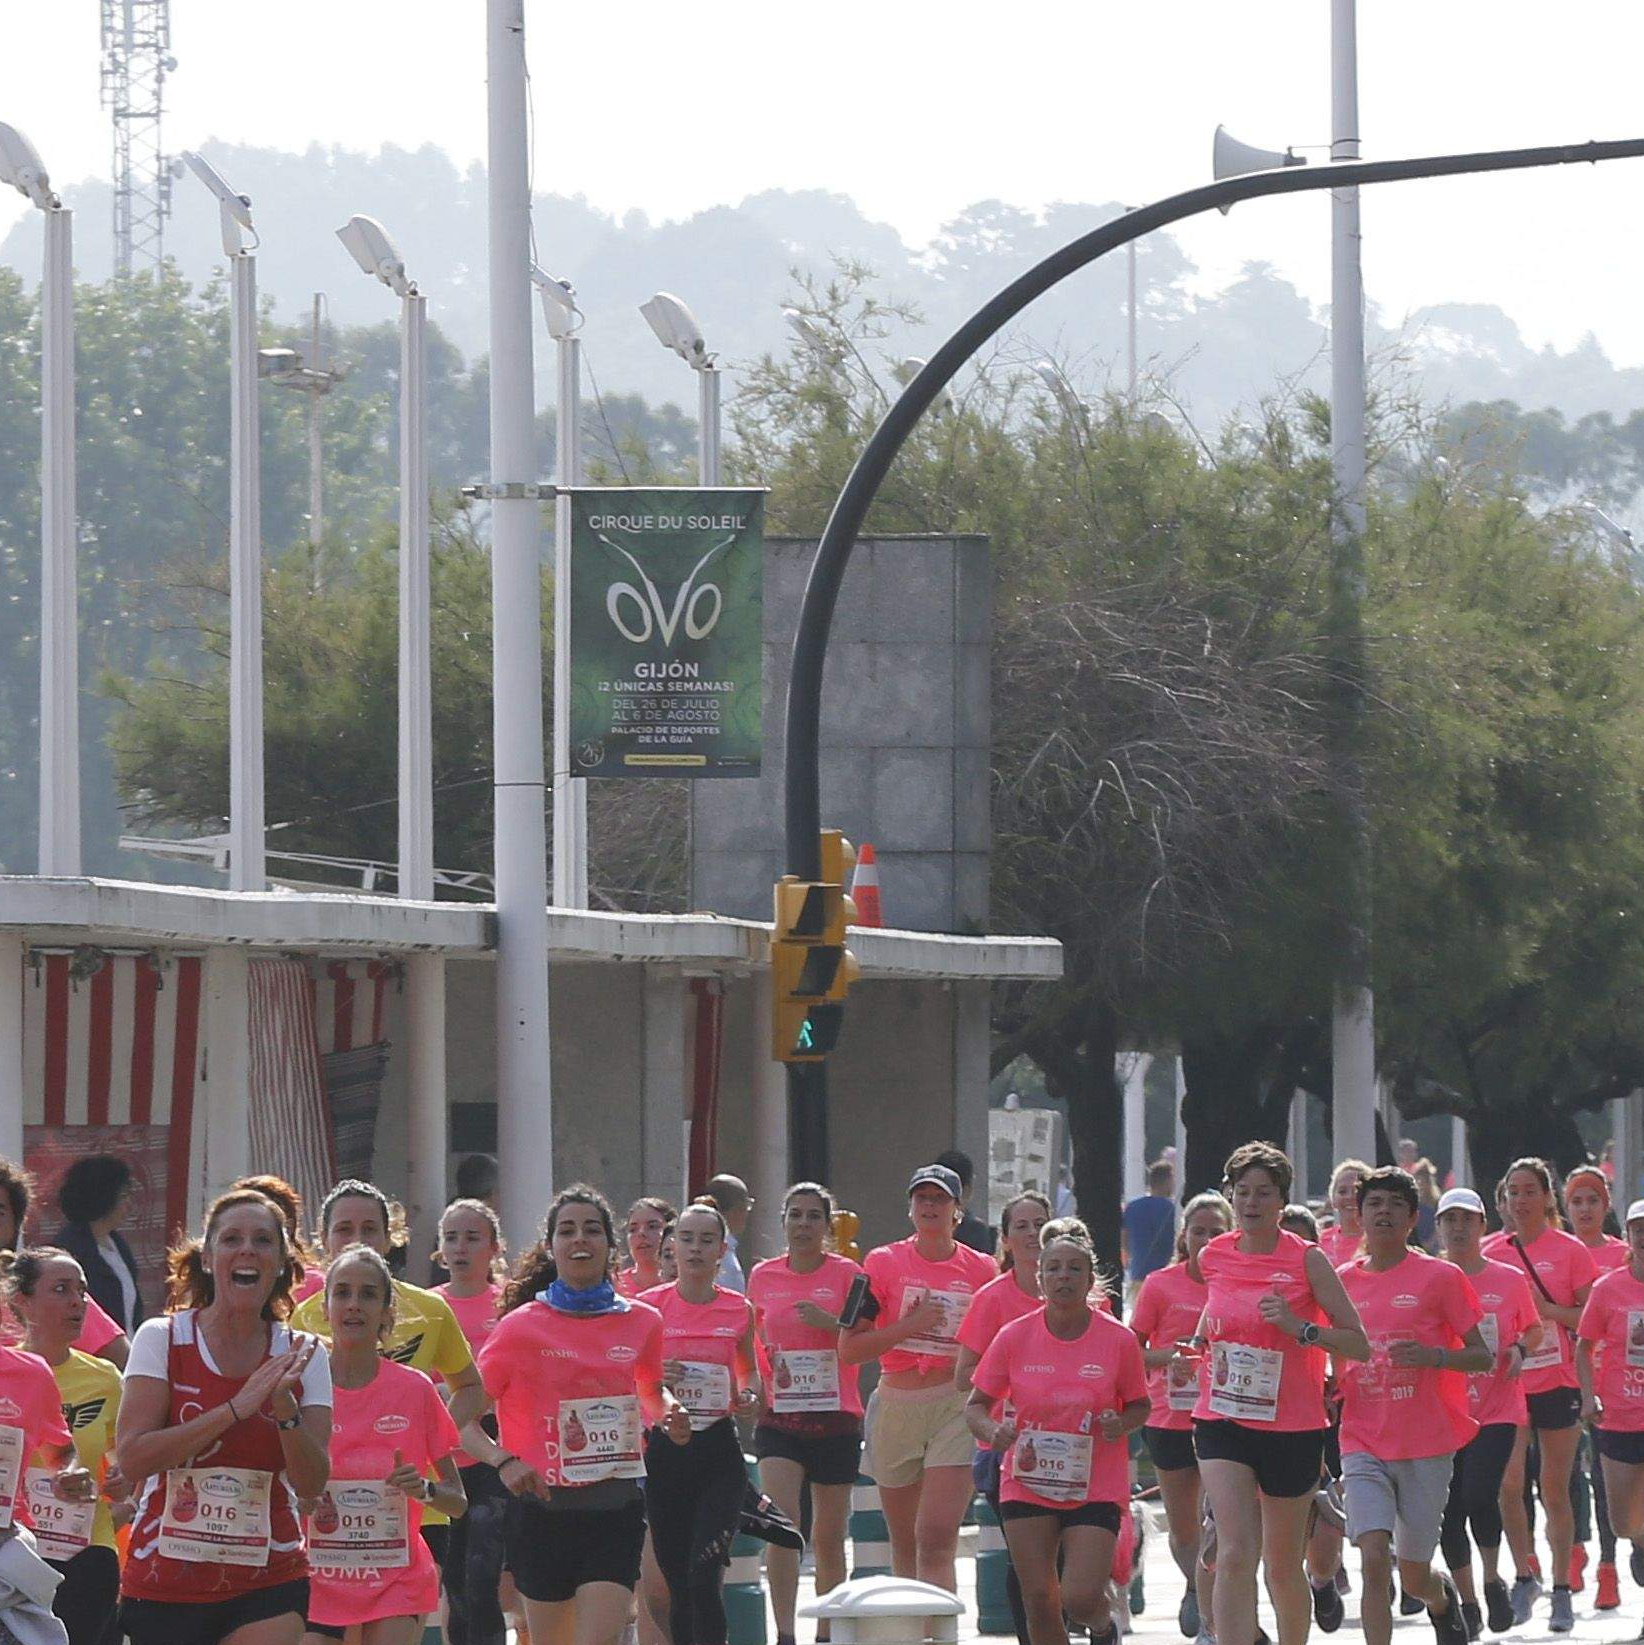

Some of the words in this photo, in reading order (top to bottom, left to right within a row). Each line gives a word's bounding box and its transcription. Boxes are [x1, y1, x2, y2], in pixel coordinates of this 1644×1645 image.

[589, 515, 653, 533] CIRQUE
[658, 515, 682, 529] DU
[687, 515, 746, 529] SOLEIL
[634, 659, 699, 679] GIJÓN
[598, 682, 611, 692] ¡2
[614, 679, 664, 692] ÚNICAS
[668, 681, 735, 692] SEMANAS!
[613, 699, 637, 709] DEL
[641, 699, 658, 709] 26
[662, 699, 678, 709] DE
[682, 699, 720, 709] JULIO
[611, 711, 629, 721] AL
[633, 711, 641, 721] 6
[645, 711, 662, 721] DE
[666, 711, 720, 721] AGOSTO
[638, 736, 652, 744] DE
[654, 736, 666, 744] LA
[794, 1375, 816, 1384] 016
[1229, 1372, 1252, 1386] 016
[677, 1388, 703, 1399] 016
[1392, 1386, 1414, 1400] 2019
[589, 1429, 619, 1443] 016
[1039, 1459, 1065, 1470] 016
[32, 1503, 64, 1519] 016
[201, 1504, 236, 1520] 016
[206, 1522, 228, 1532] 1097
[342, 1515, 375, 1528] 016
